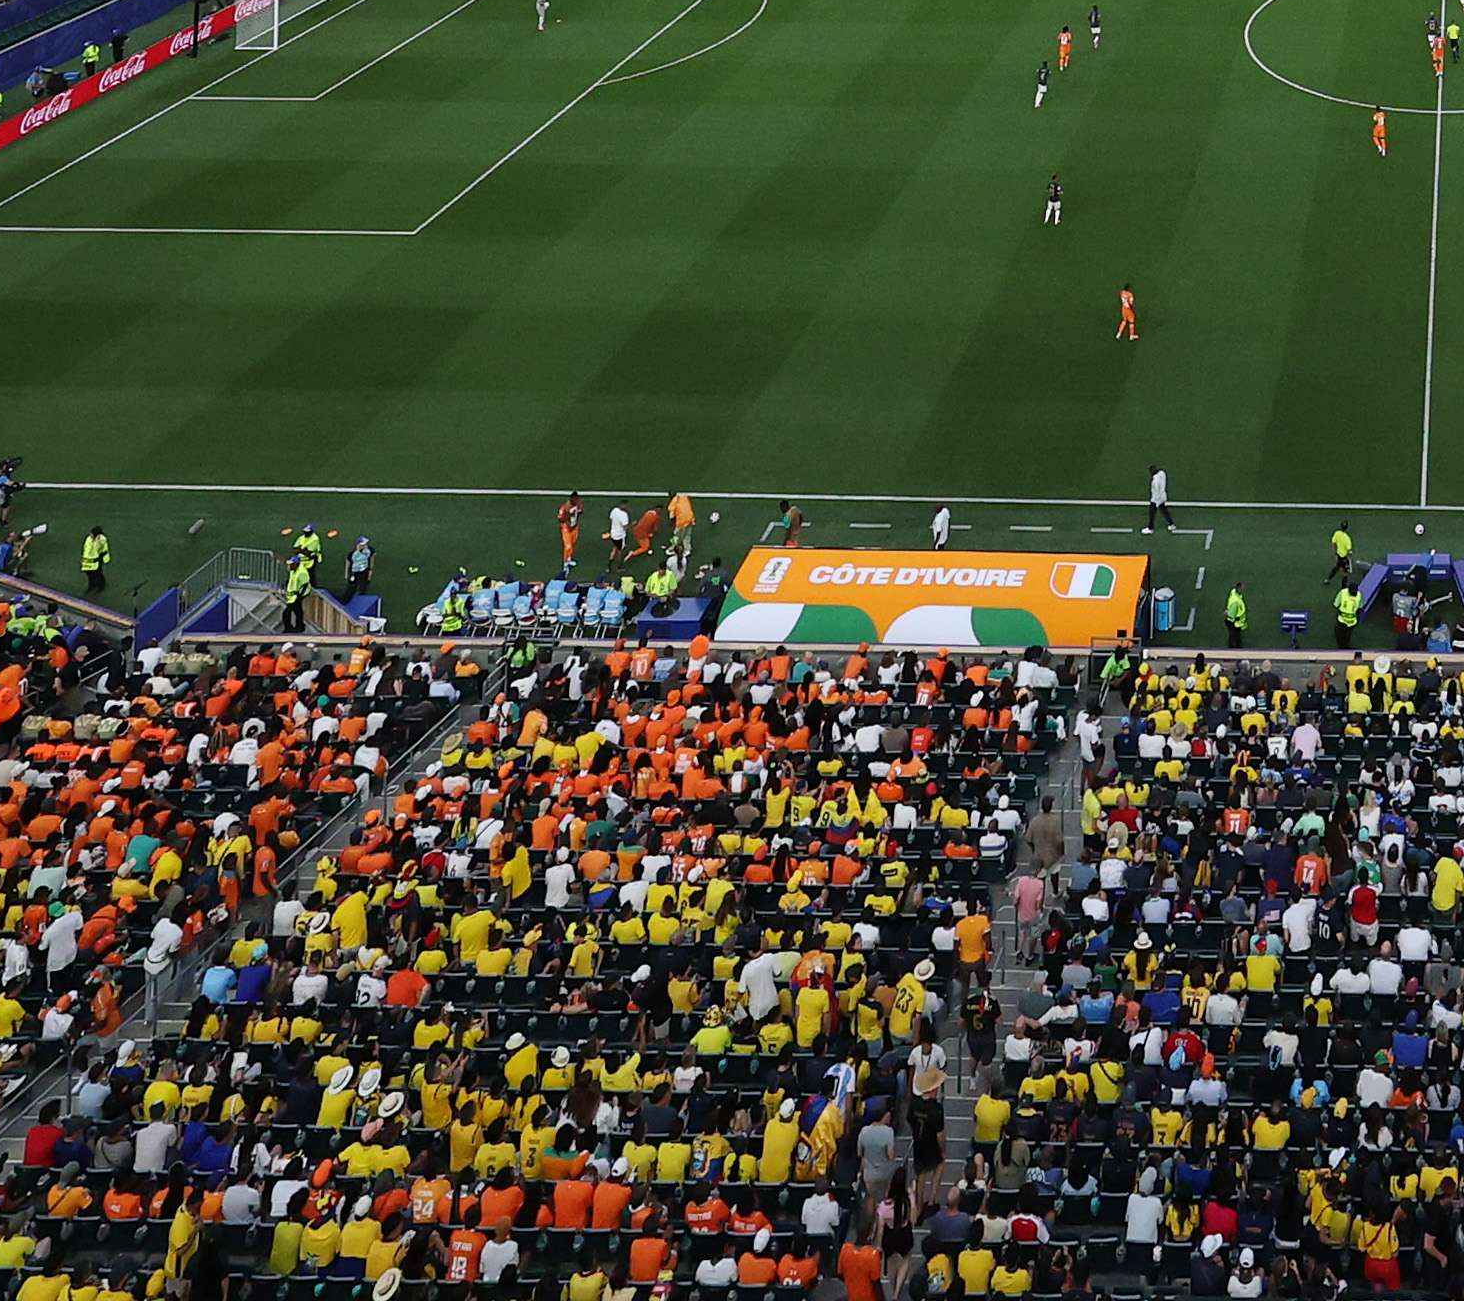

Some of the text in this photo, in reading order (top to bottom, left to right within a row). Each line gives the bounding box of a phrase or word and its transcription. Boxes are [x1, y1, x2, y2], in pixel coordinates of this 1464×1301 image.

[99, 51, 147, 93] Coca-Cola
[20, 88, 74, 135] Coca-Cola
[808, 563, 1027, 587] CÔTE D'IVOIRE
[1318, 923, 1331, 939] 10
